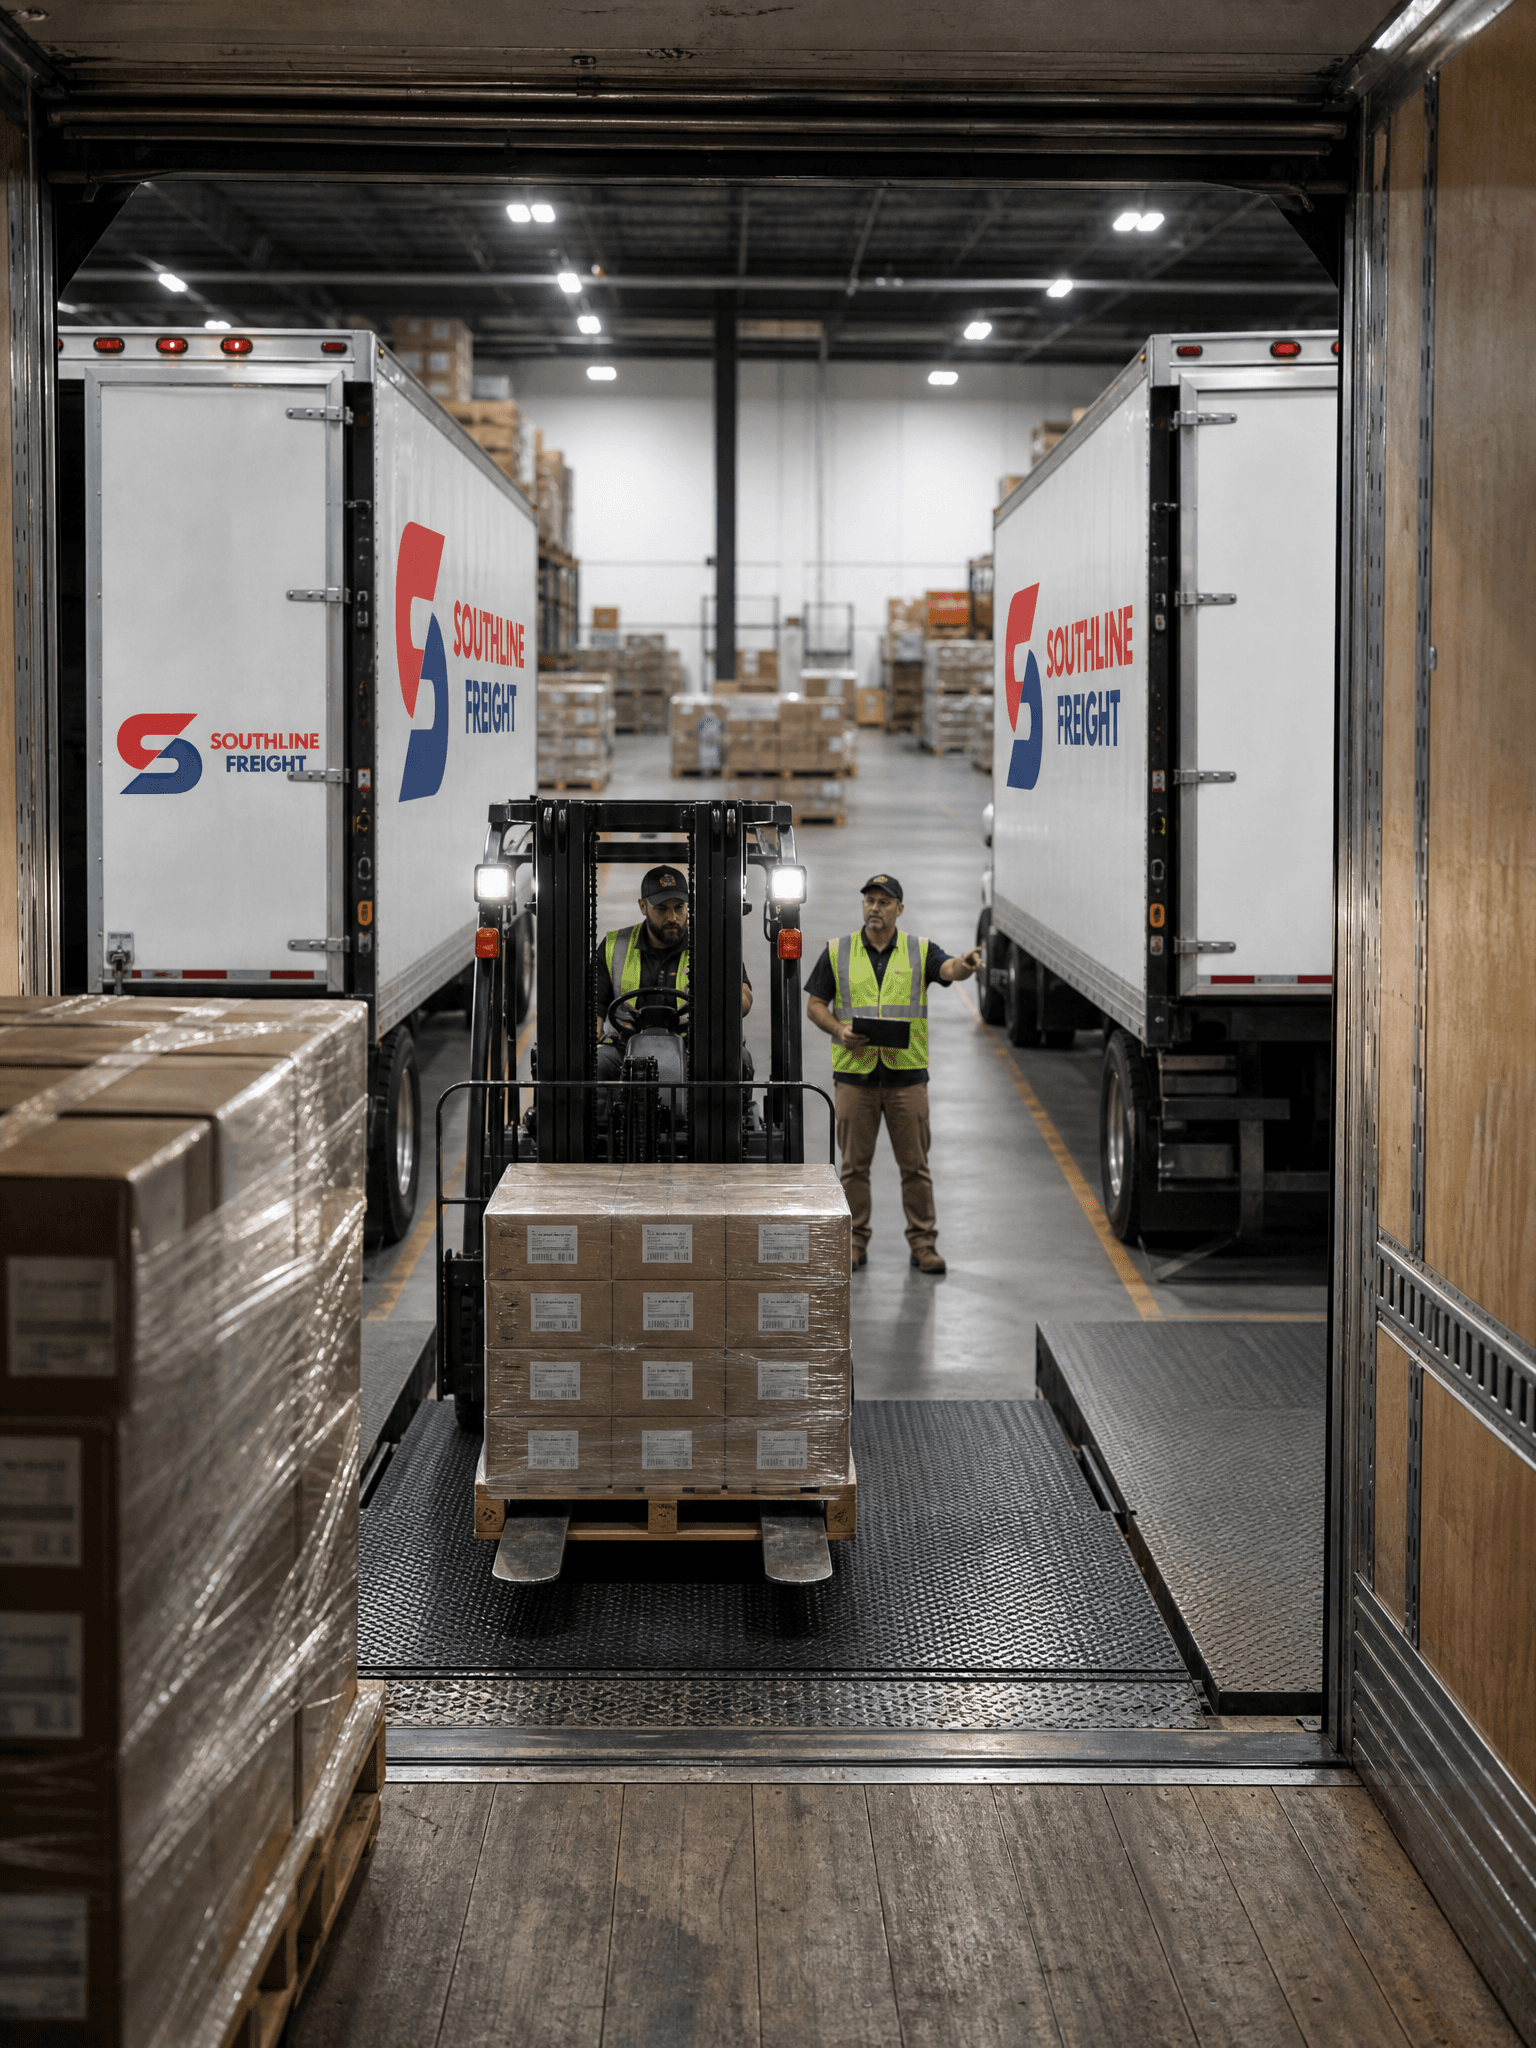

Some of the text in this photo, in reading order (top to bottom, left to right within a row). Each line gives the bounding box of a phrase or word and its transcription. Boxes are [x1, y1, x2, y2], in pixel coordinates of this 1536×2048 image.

[454, 599, 525, 669] SOUTHLINE
[1047, 604, 1133, 679] SOUTHLINE
[466, 679, 517, 734] FREIGHT
[1058, 689, 1121, 747] FREIGHT
[210, 732, 320, 750] SOUTHLINE
[226, 755, 307, 773] FREIGHT
